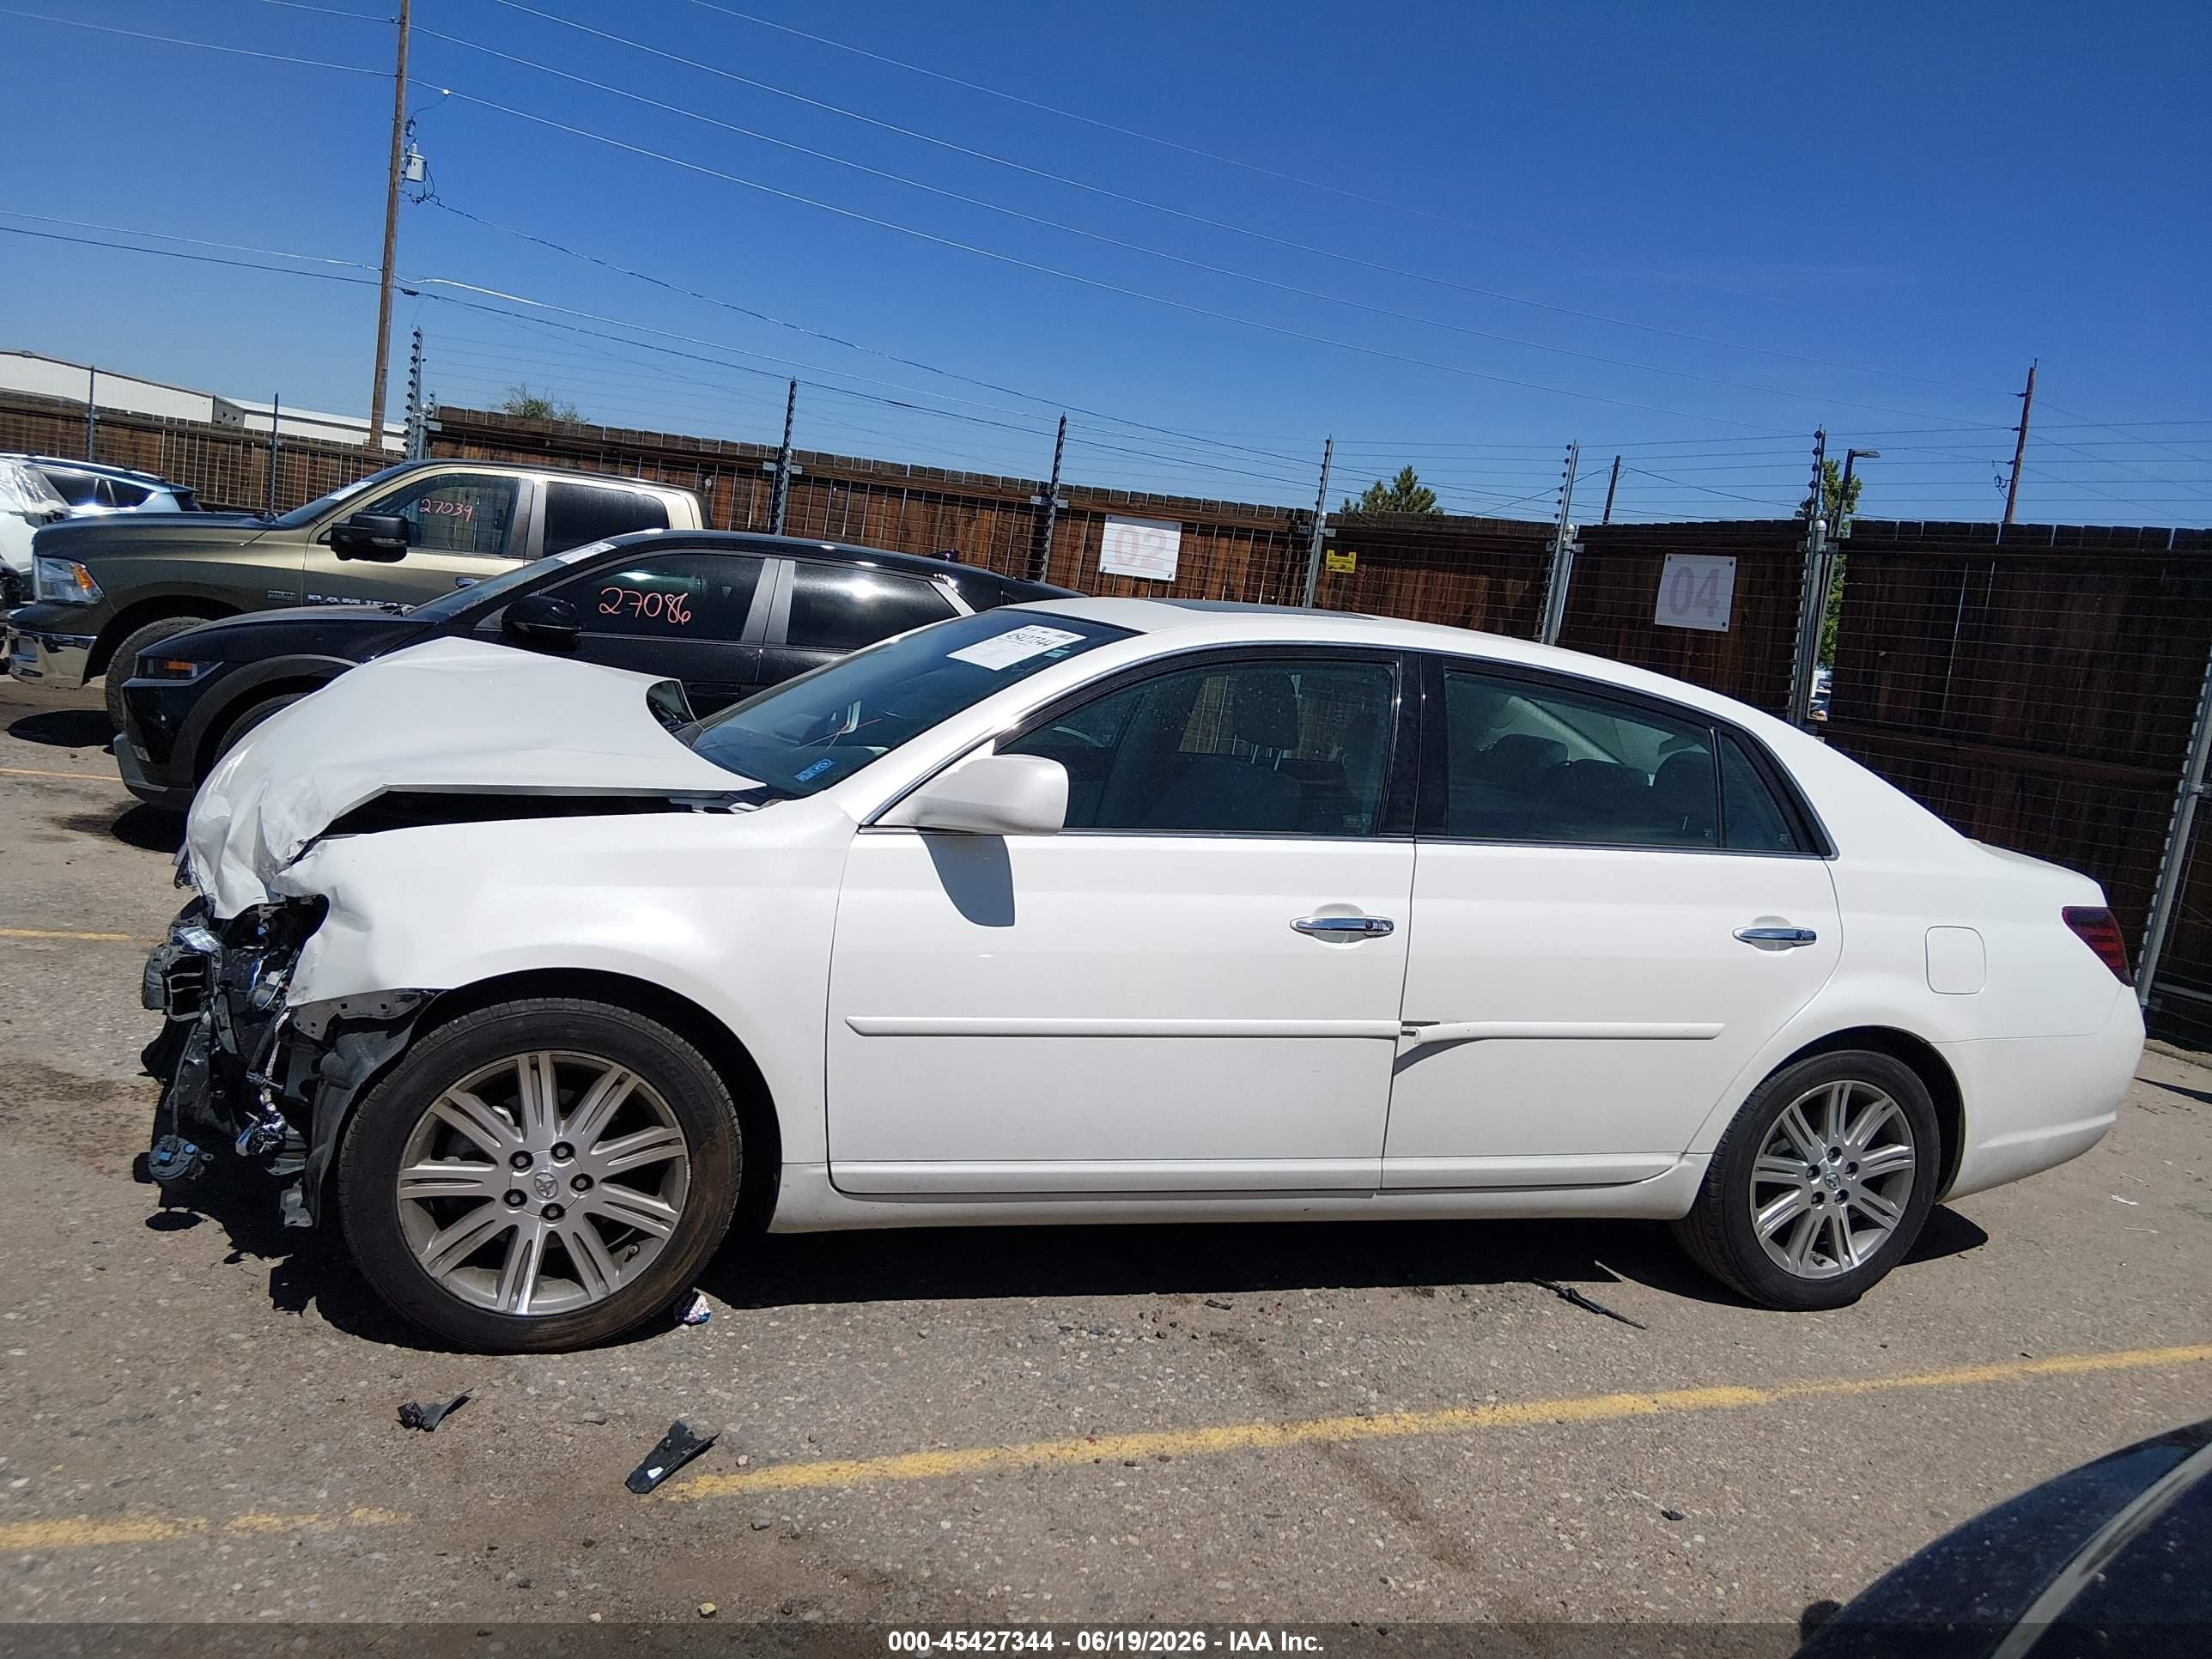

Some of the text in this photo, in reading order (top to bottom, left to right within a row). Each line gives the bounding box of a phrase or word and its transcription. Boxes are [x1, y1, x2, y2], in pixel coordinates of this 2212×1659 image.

[418, 498, 474, 523] 27039
[1114, 525, 1168, 570] 02
[599, 586, 692, 626] 27086
[1668, 565, 1720, 618] 04
